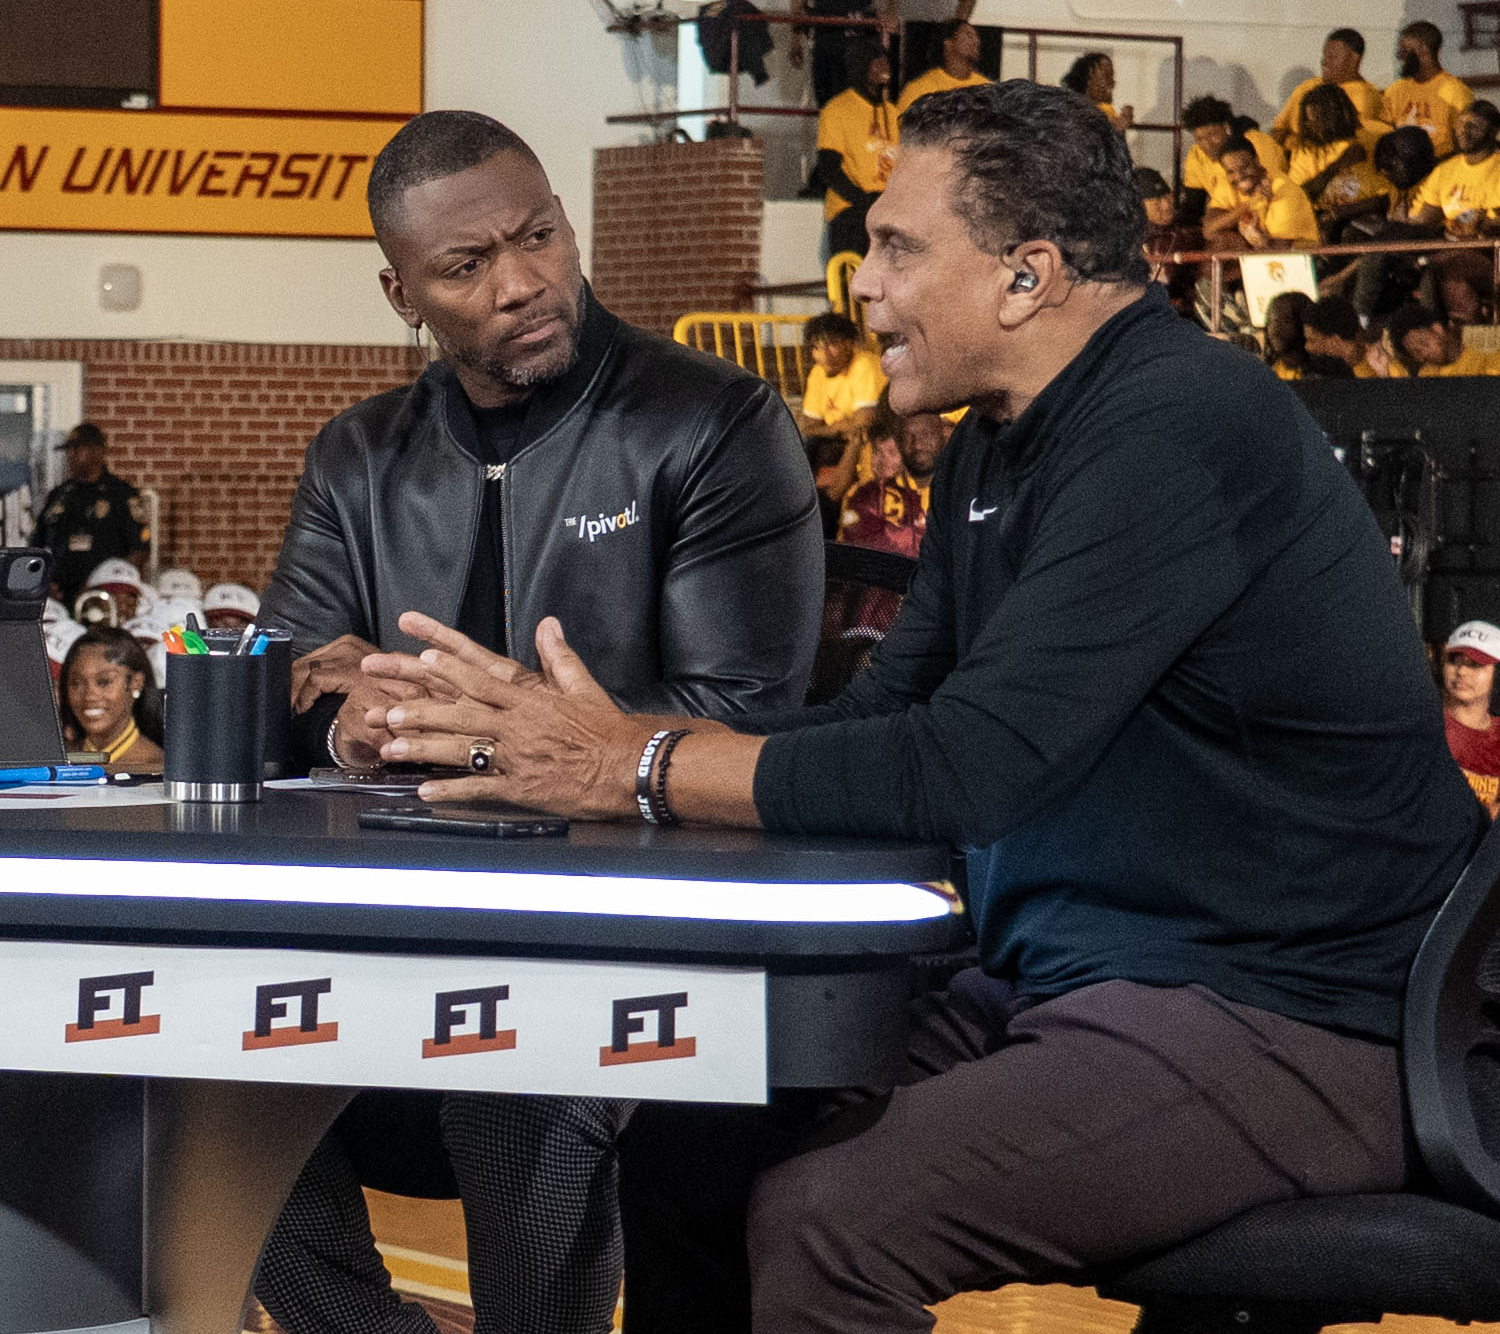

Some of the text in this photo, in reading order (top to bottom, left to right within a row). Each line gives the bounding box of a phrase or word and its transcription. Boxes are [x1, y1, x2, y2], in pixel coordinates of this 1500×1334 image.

[61, 146, 378, 201] UNIVERSIT
[1458, 629, 1489, 643] BCU
[637, 739, 661, 778] LORD
[76, 970, 155, 1030] FT
[254, 977, 333, 1038] FT
[434, 984, 511, 1045] FT
[611, 991, 689, 1052] FT
